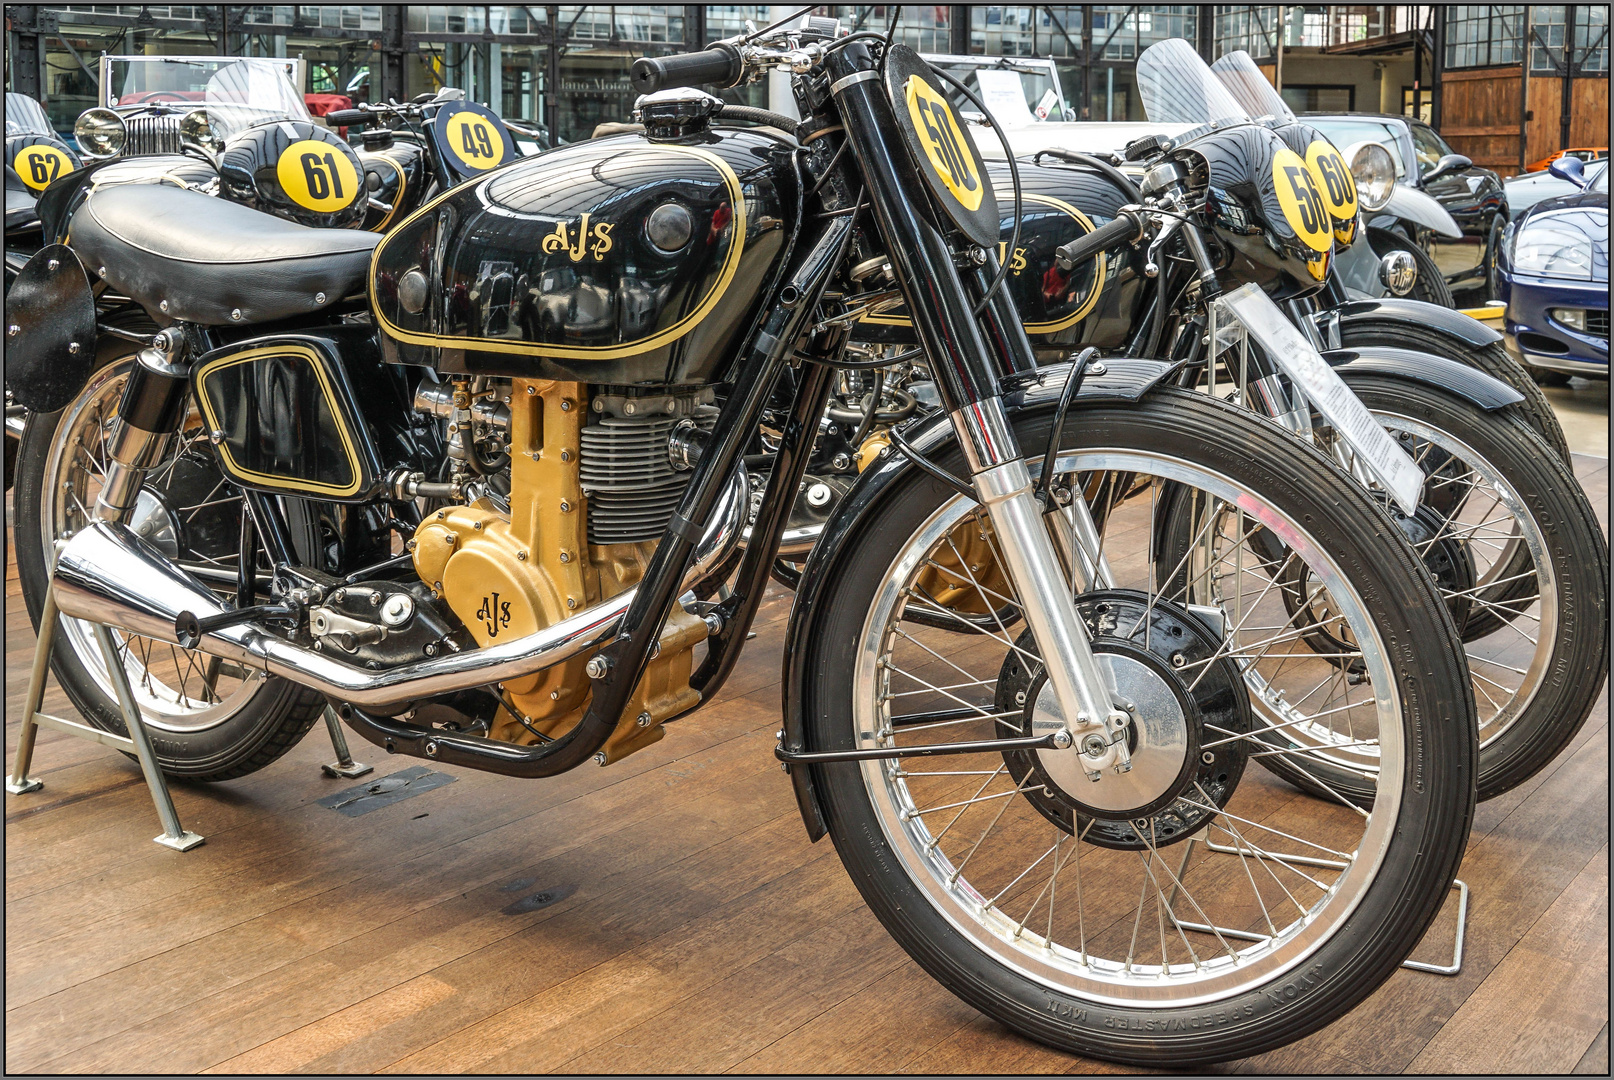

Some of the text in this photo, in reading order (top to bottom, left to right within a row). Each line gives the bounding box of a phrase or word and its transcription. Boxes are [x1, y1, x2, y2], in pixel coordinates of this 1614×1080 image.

[461, 123, 494, 158] 49
[915, 92, 977, 191] 50
[27, 152, 61, 184] 62
[300, 152, 345, 201] 61
[1316, 153, 1354, 207] 60
[1283, 166, 1330, 234] 56
[1528, 494, 1558, 537] AVON
[1556, 546, 1576, 648] SPEEDMASTER
[1271, 962, 1326, 1010] AVON
[1103, 1004, 1255, 1033] SPEEDMASTER
